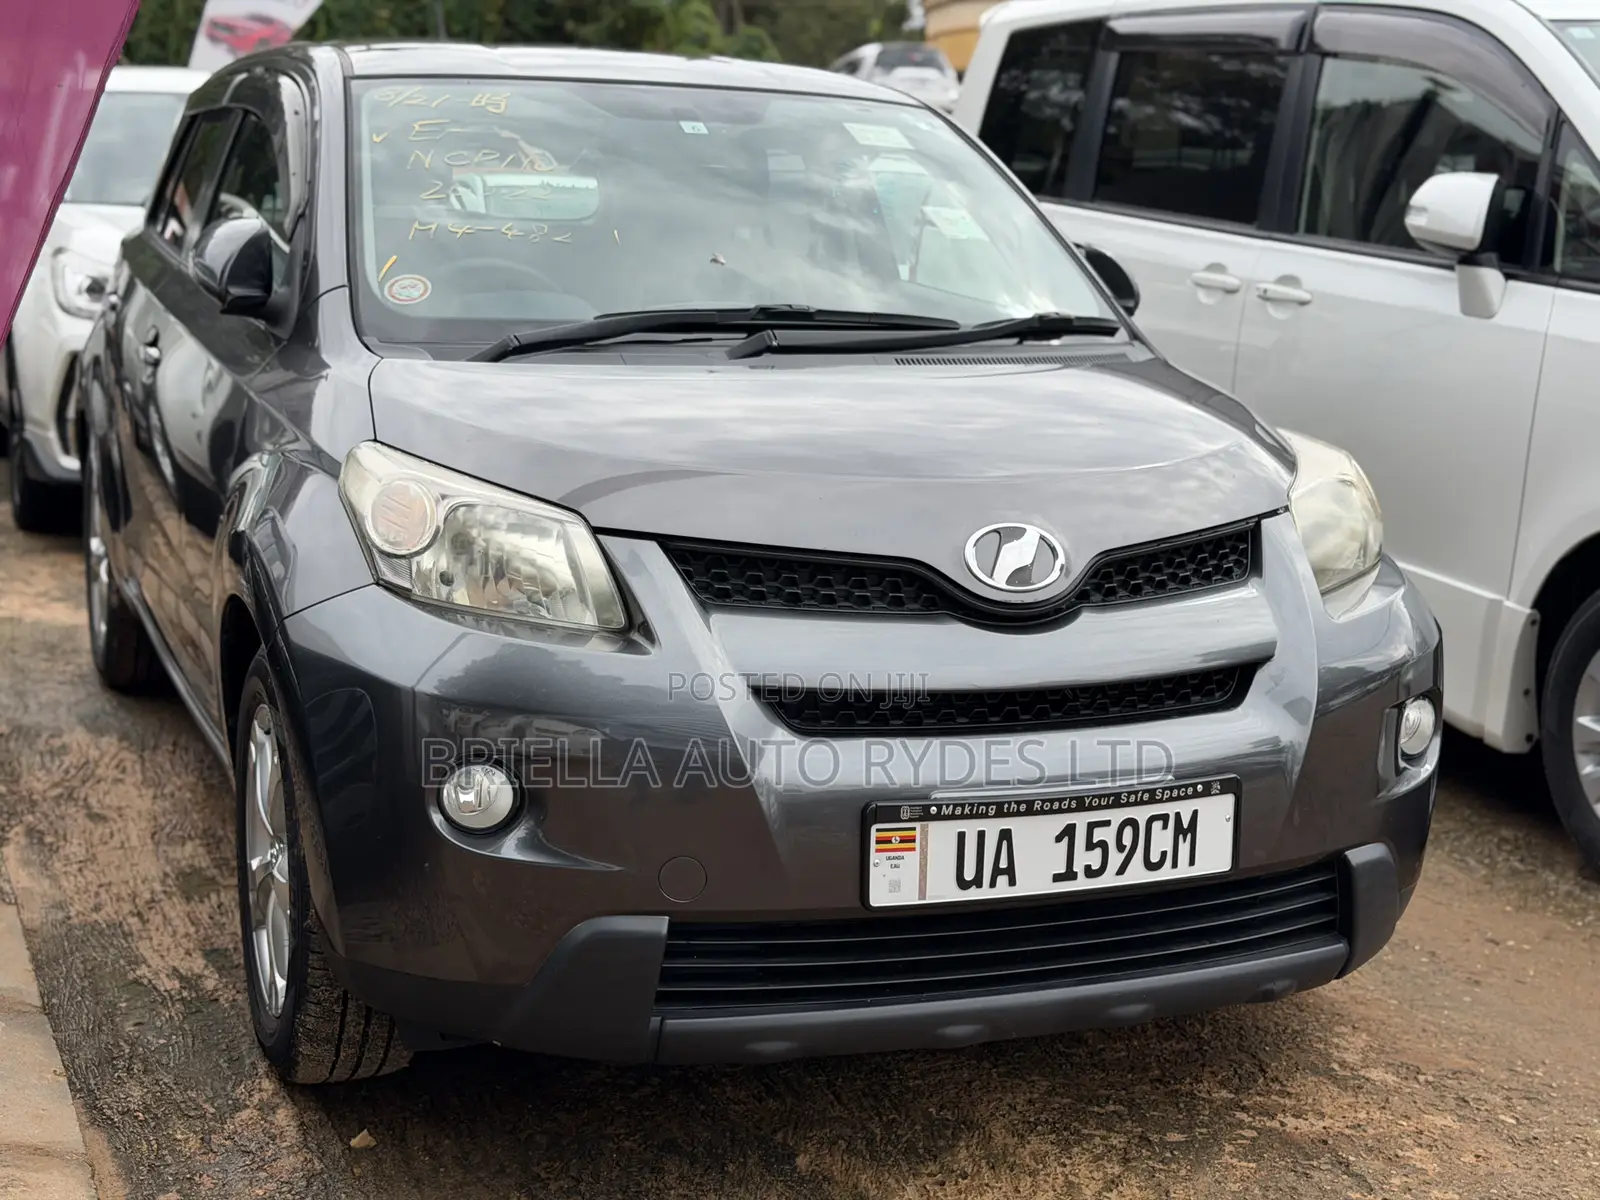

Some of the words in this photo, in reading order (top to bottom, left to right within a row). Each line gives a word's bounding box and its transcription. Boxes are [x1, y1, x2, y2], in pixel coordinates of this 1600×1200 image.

[940, 803, 997, 816] Making
[1003, 801, 1027, 813] the
[1033, 798, 1077, 811] Roads
[1084, 795, 1115, 808] Your
[1120, 792, 1149, 804] Safe
[1155, 786, 1194, 801] Space
[955, 828, 1017, 890] UA
[1052, 809, 1199, 883] 159CM
